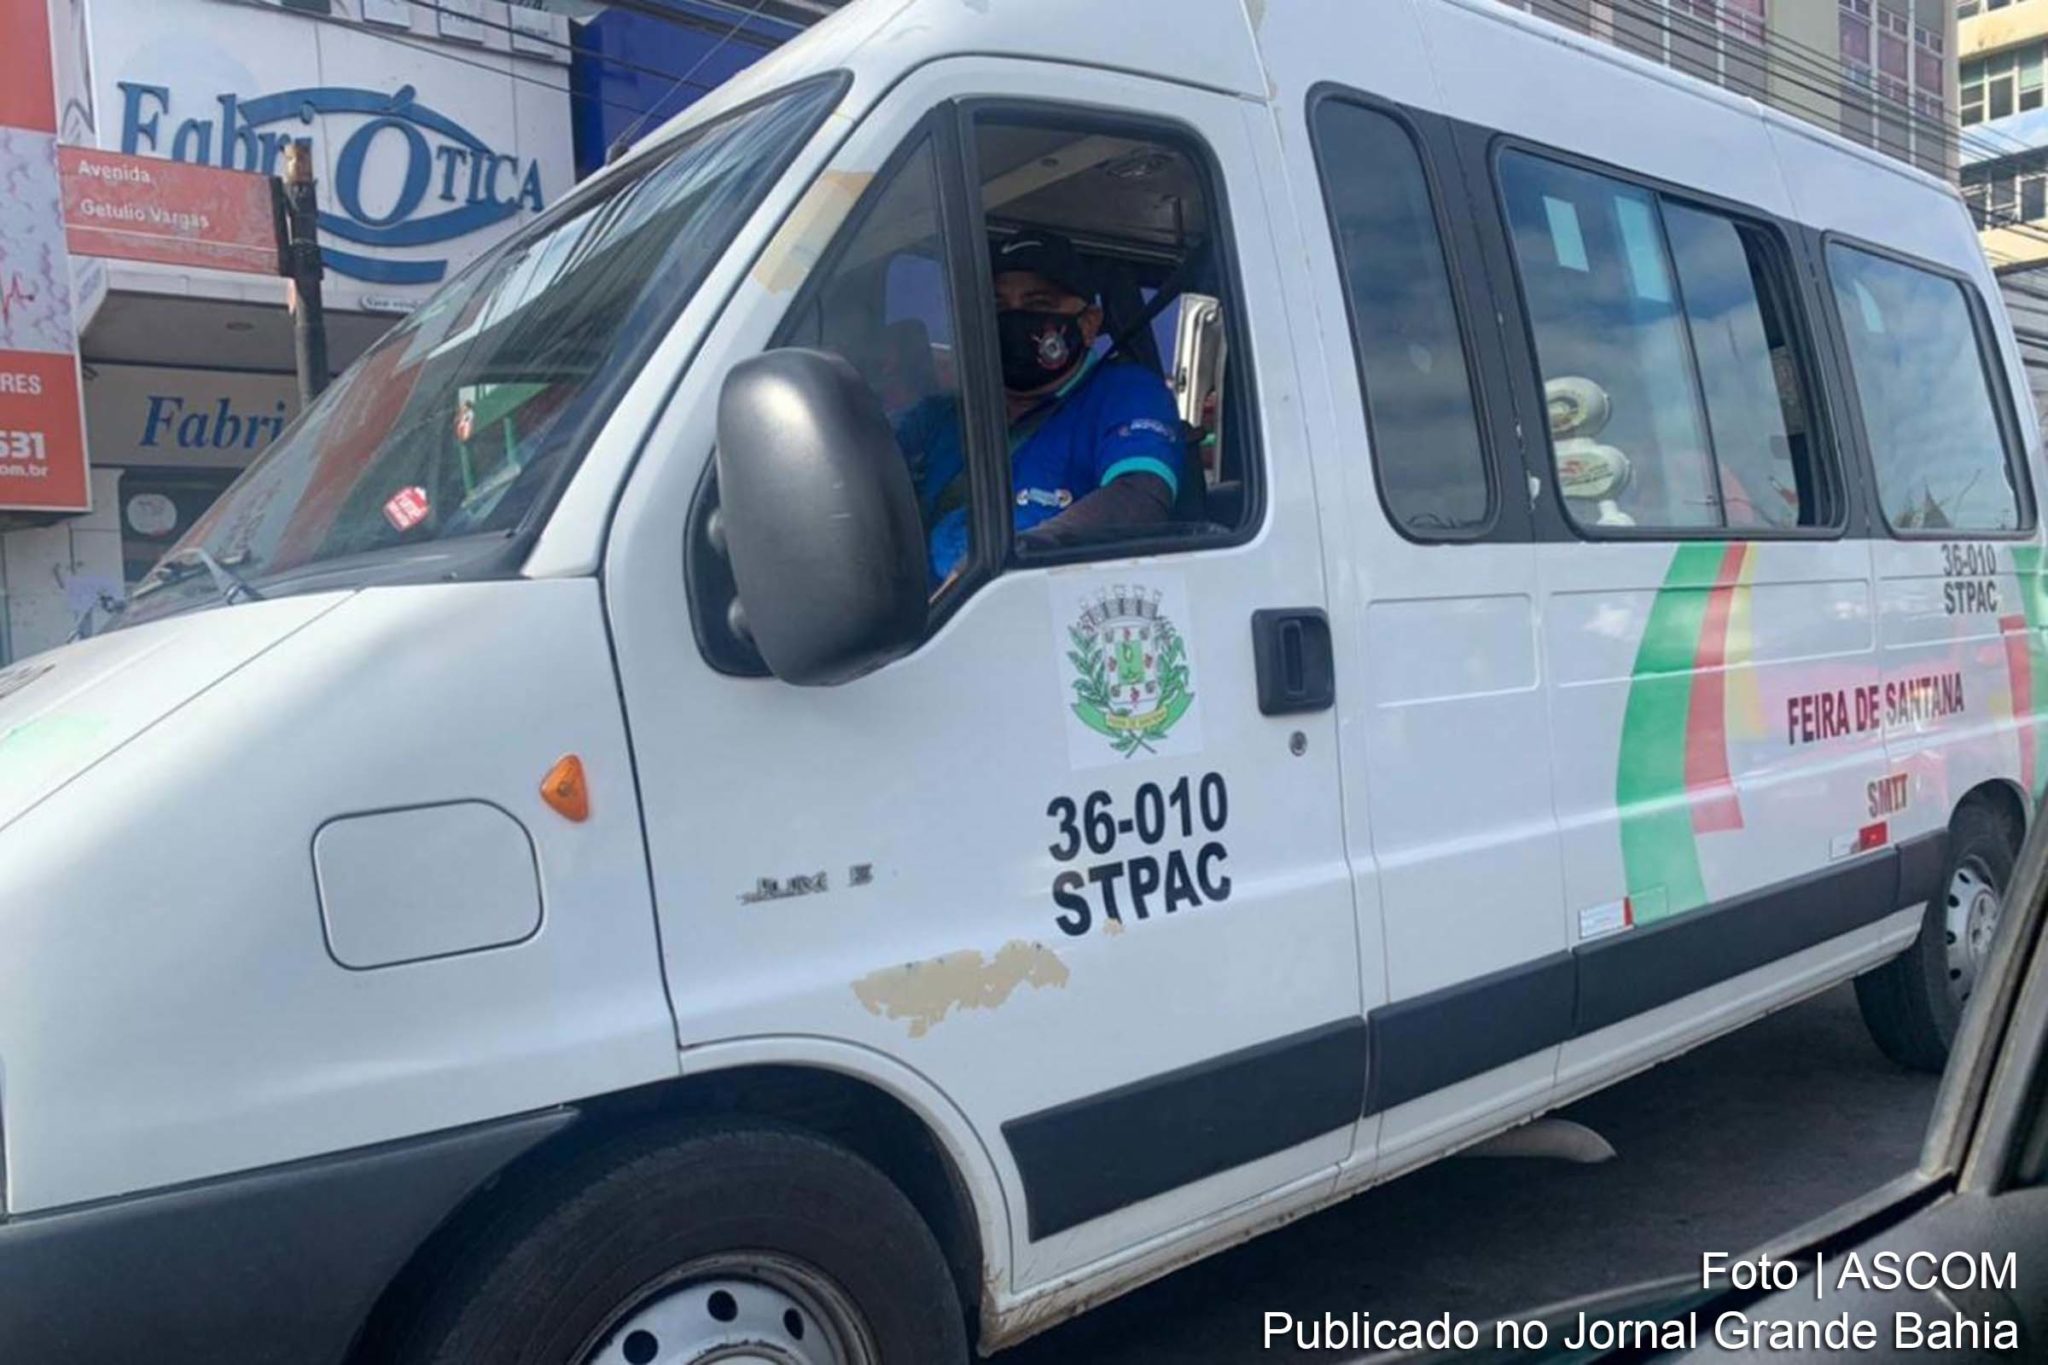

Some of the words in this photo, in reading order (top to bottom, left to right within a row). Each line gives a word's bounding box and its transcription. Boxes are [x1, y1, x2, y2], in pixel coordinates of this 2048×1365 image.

[78, 159, 151, 184] Avenida
[80, 198, 146, 222] Getulio
[149, 205, 210, 231] Vargas
[138, 395, 287, 448] Fabri
[1941, 543, 1997, 577] 36-010
[1943, 580, 1998, 615] STPAC
[1788, 690, 1850, 746] FEIRA
[1855, 685, 1880, 732] DE
[1885, 672, 1965, 727] SANTANA
[1046, 772, 1229, 862] 36-010
[1867, 773, 1908, 818] SMTT
[1051, 842, 1232, 937] STPAC
